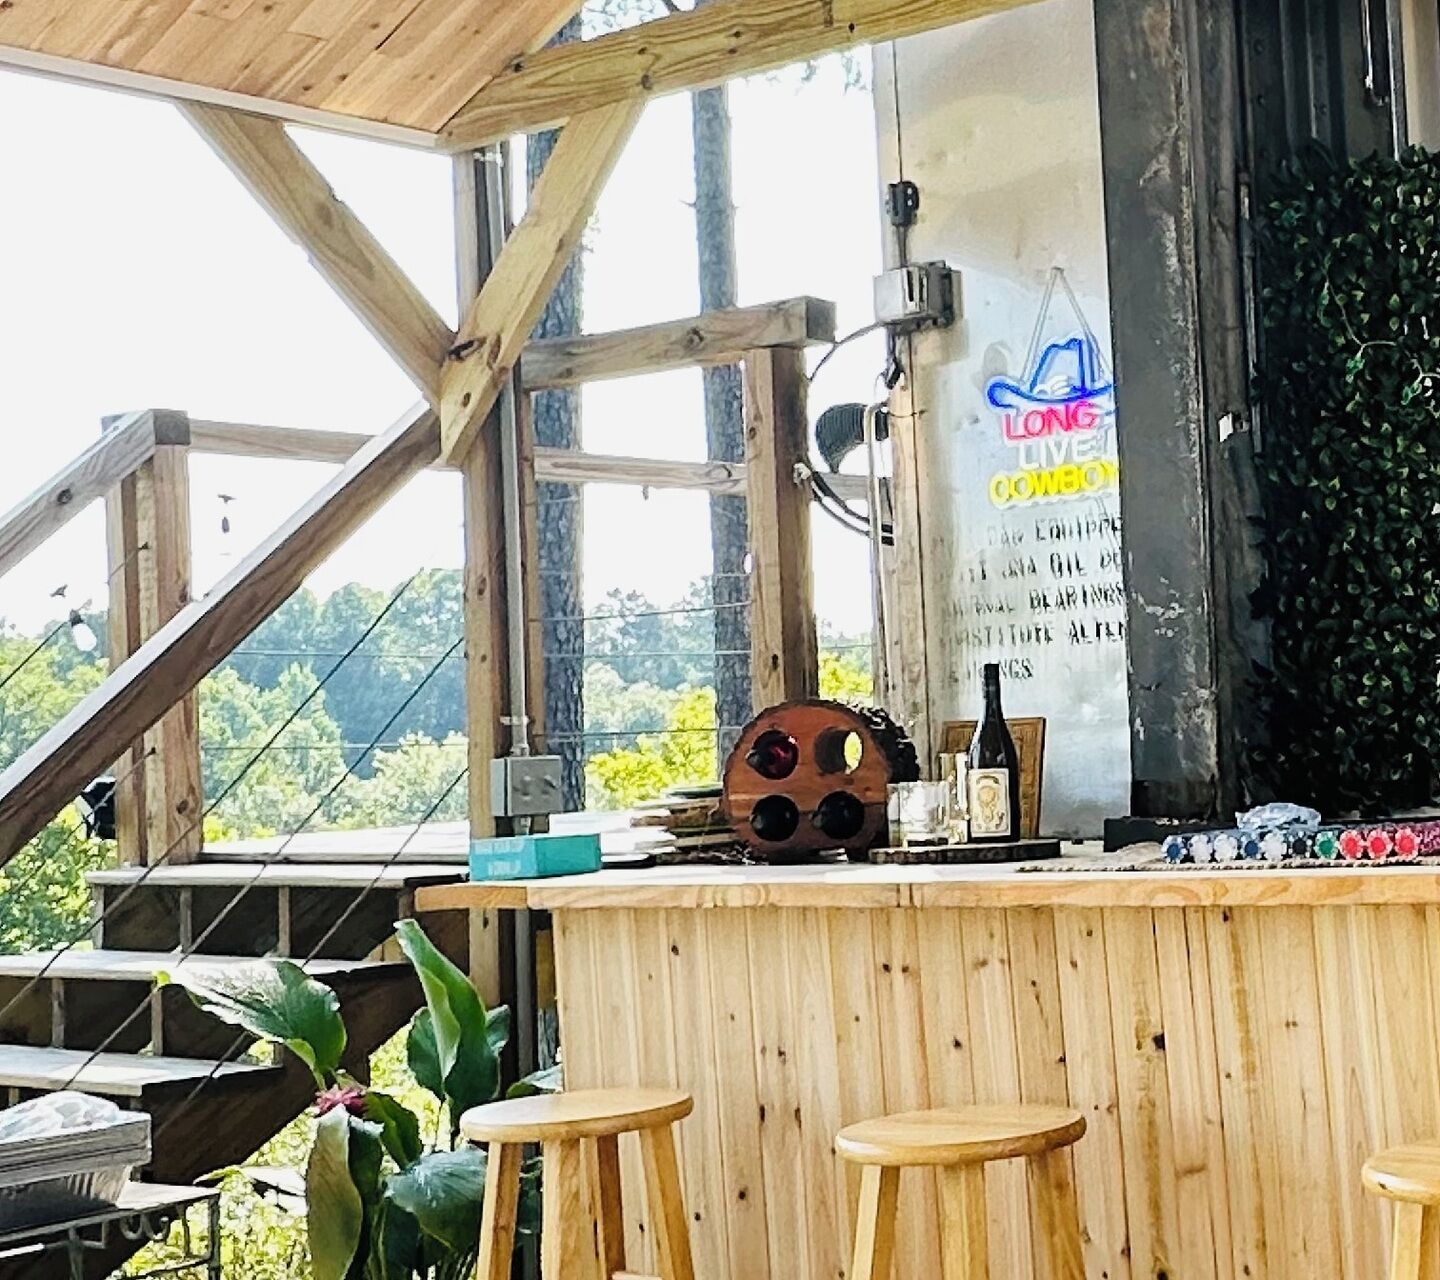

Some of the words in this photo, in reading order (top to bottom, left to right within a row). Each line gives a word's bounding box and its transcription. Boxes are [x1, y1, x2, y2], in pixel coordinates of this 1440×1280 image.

[1004, 400, 1099, 441] LONG
[1018, 435, 1098, 470] LIVE
[990, 458, 1119, 507] COWBOY
